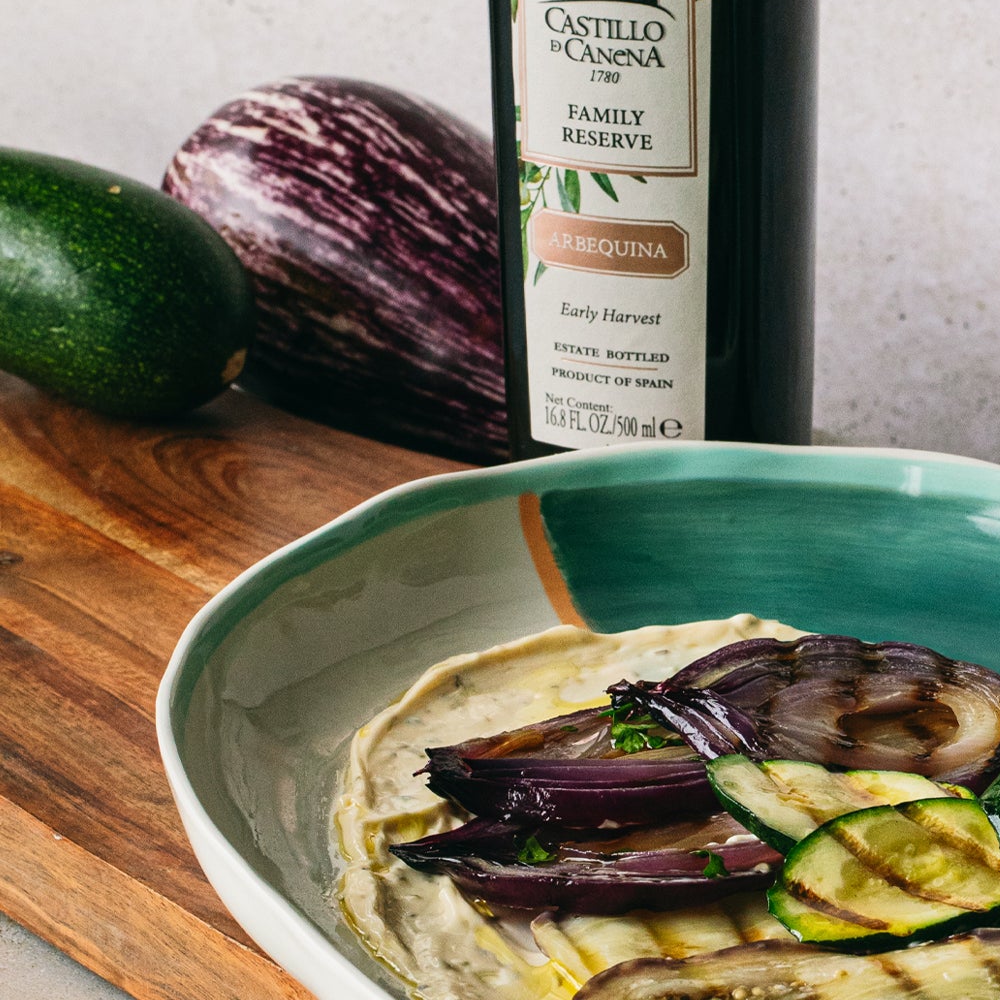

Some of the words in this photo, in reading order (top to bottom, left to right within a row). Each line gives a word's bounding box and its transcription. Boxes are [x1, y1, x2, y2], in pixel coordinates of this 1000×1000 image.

[544, 6, 666, 42] CASTILLO
[590, 69, 620, 84] 1780
[568, 104, 645, 126] FAMILY
[562, 126, 653, 151] RESERVE
[549, 231, 668, 259] ARBEQUINA
[560, 302, 598, 323] Early
[602, 308, 662, 325] Harvest
[554, 341, 599, 358] ESTATE
[606, 349, 670, 363] BOTTLED
[551, 367, 611, 385] PRODUCT
[614, 376, 632, 387] OF
[635, 378, 673, 389] SPAIN
[545, 392, 563, 405] Net
[566, 396, 613, 413] Content:
[545, 405, 566, 430] 16.8
[569, 410, 586, 432] FL.
[641, 416, 656, 438] ml
